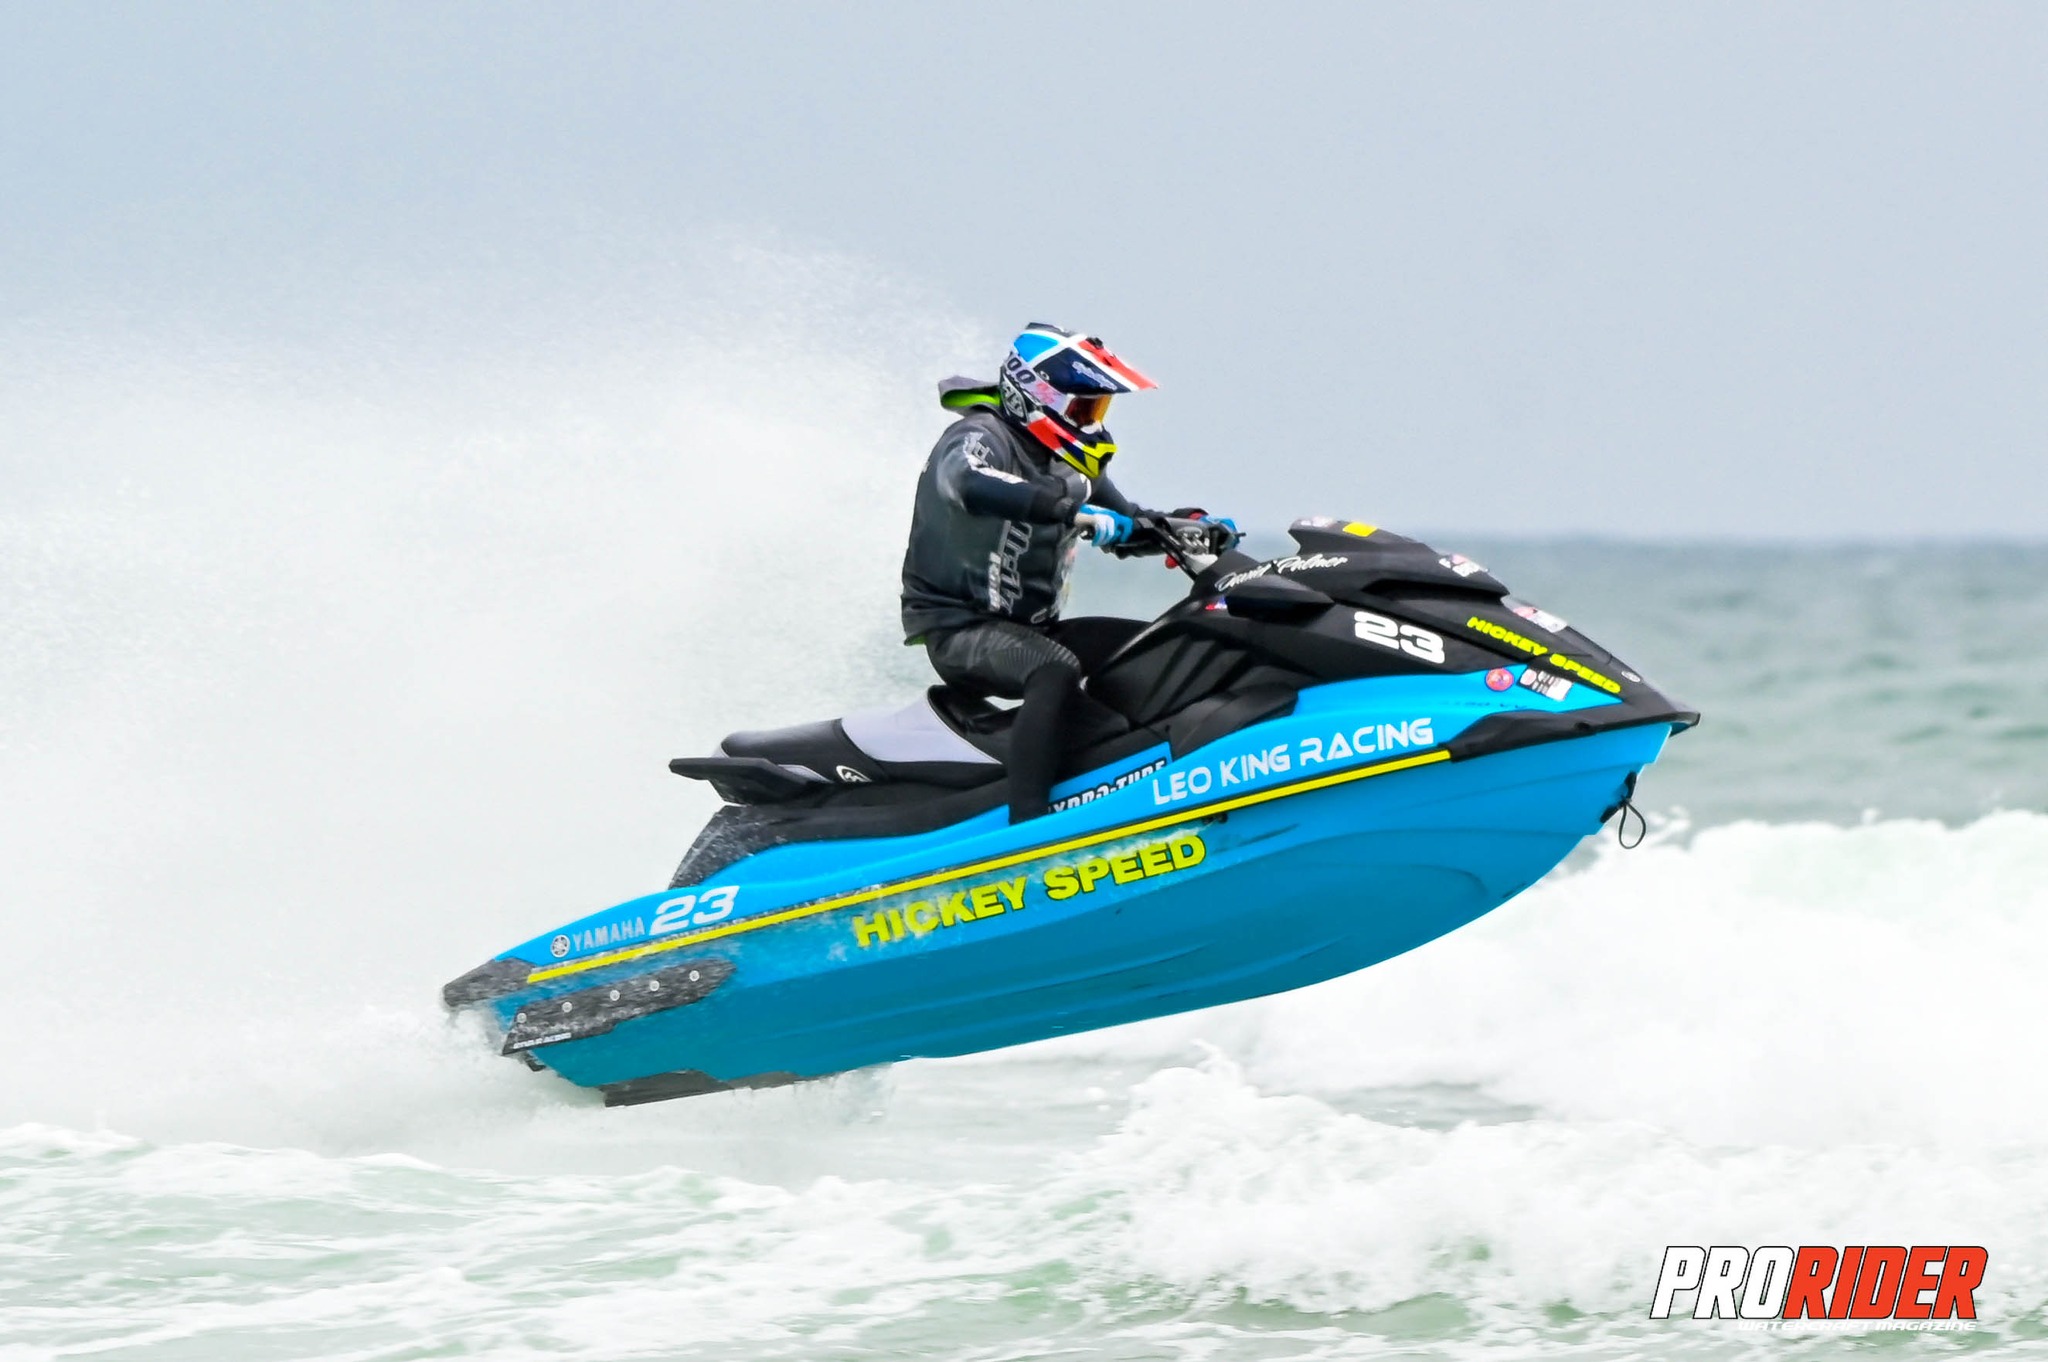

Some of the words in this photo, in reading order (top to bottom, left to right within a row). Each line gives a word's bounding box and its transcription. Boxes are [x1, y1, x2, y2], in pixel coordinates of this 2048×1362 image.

[1354, 611, 1445, 664] 23
[1467, 617, 1548, 656] HICKEY
[1550, 653, 1621, 693] SPEED
[1152, 767, 1212, 806] LEO
[1220, 744, 1291, 787] KING
[1300, 717, 1434, 766] RACING
[572, 917, 646, 952] YAMAHA
[650, 885, 740, 936] 23
[852, 876, 1027, 949] HICKEY
[1043, 834, 1207, 902] SPEED
